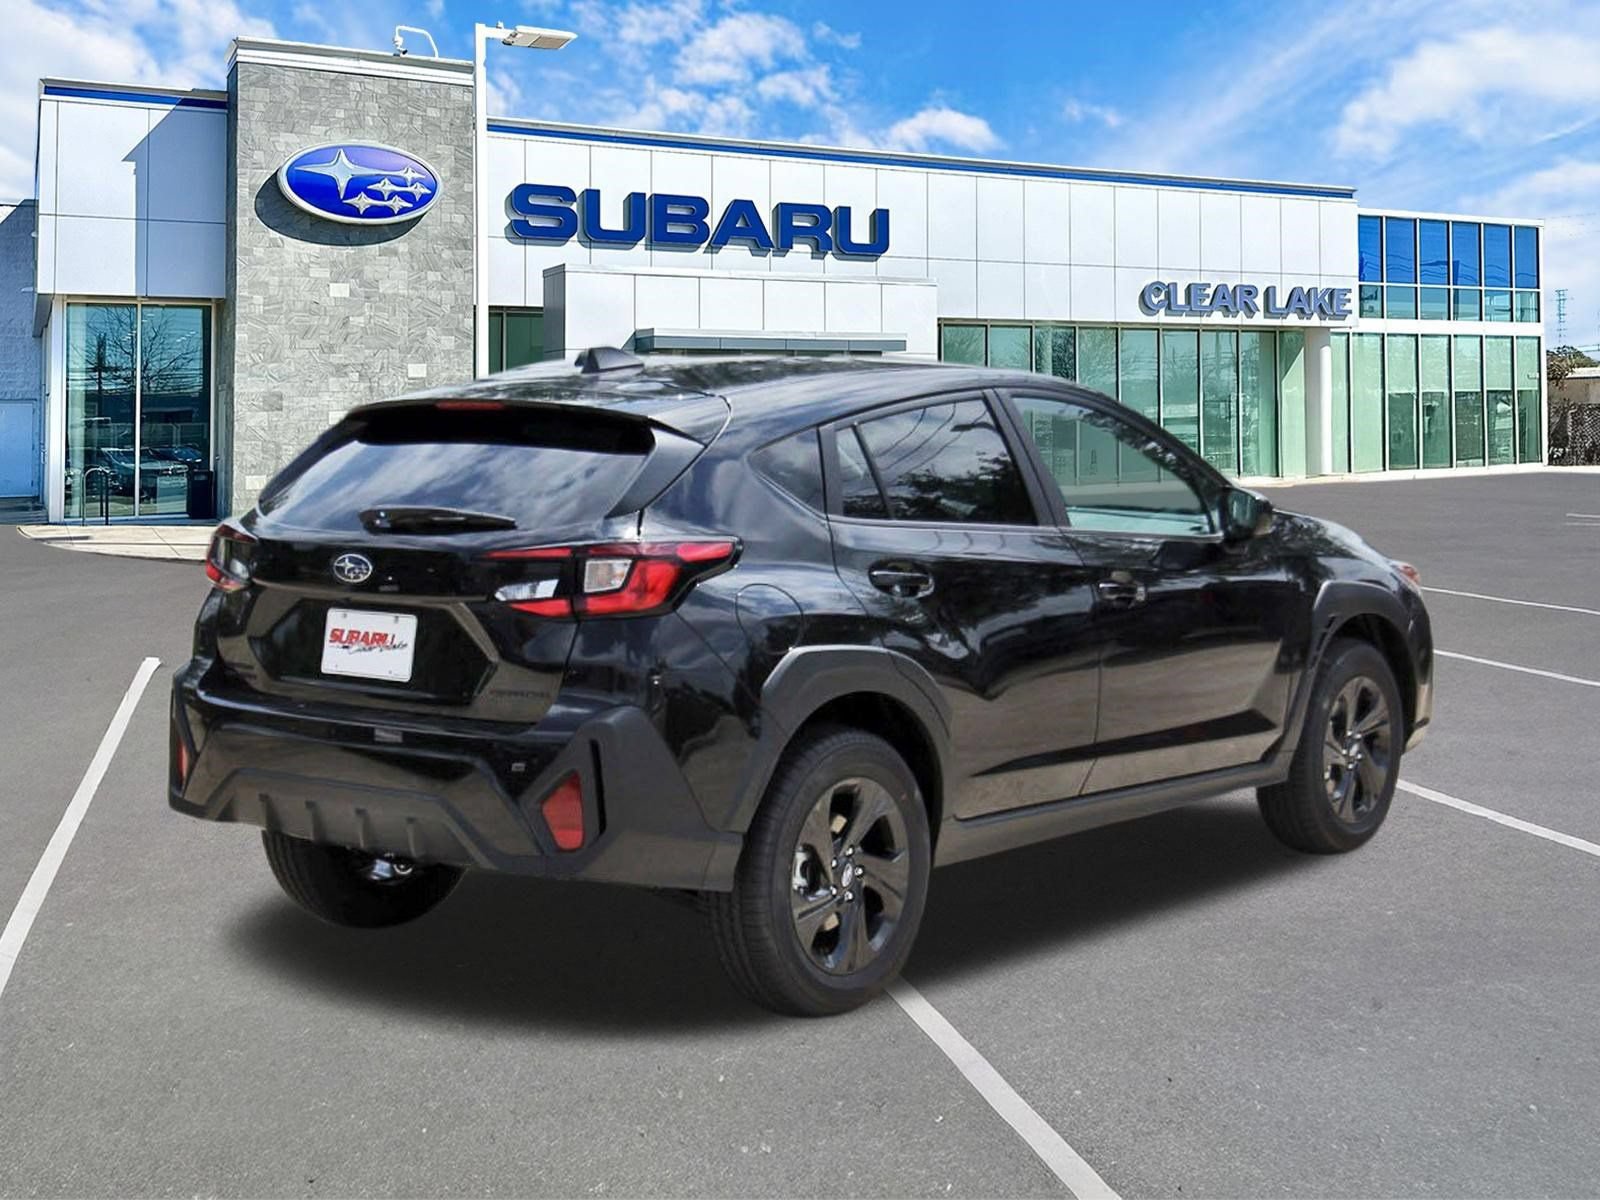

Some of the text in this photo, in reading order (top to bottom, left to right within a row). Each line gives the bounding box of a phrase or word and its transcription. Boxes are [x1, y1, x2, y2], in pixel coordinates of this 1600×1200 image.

[506, 184, 889, 260] SUBARU
[1139, 281, 1352, 320] CLEAR LAKE
[329, 628, 396, 646] SUBARU
